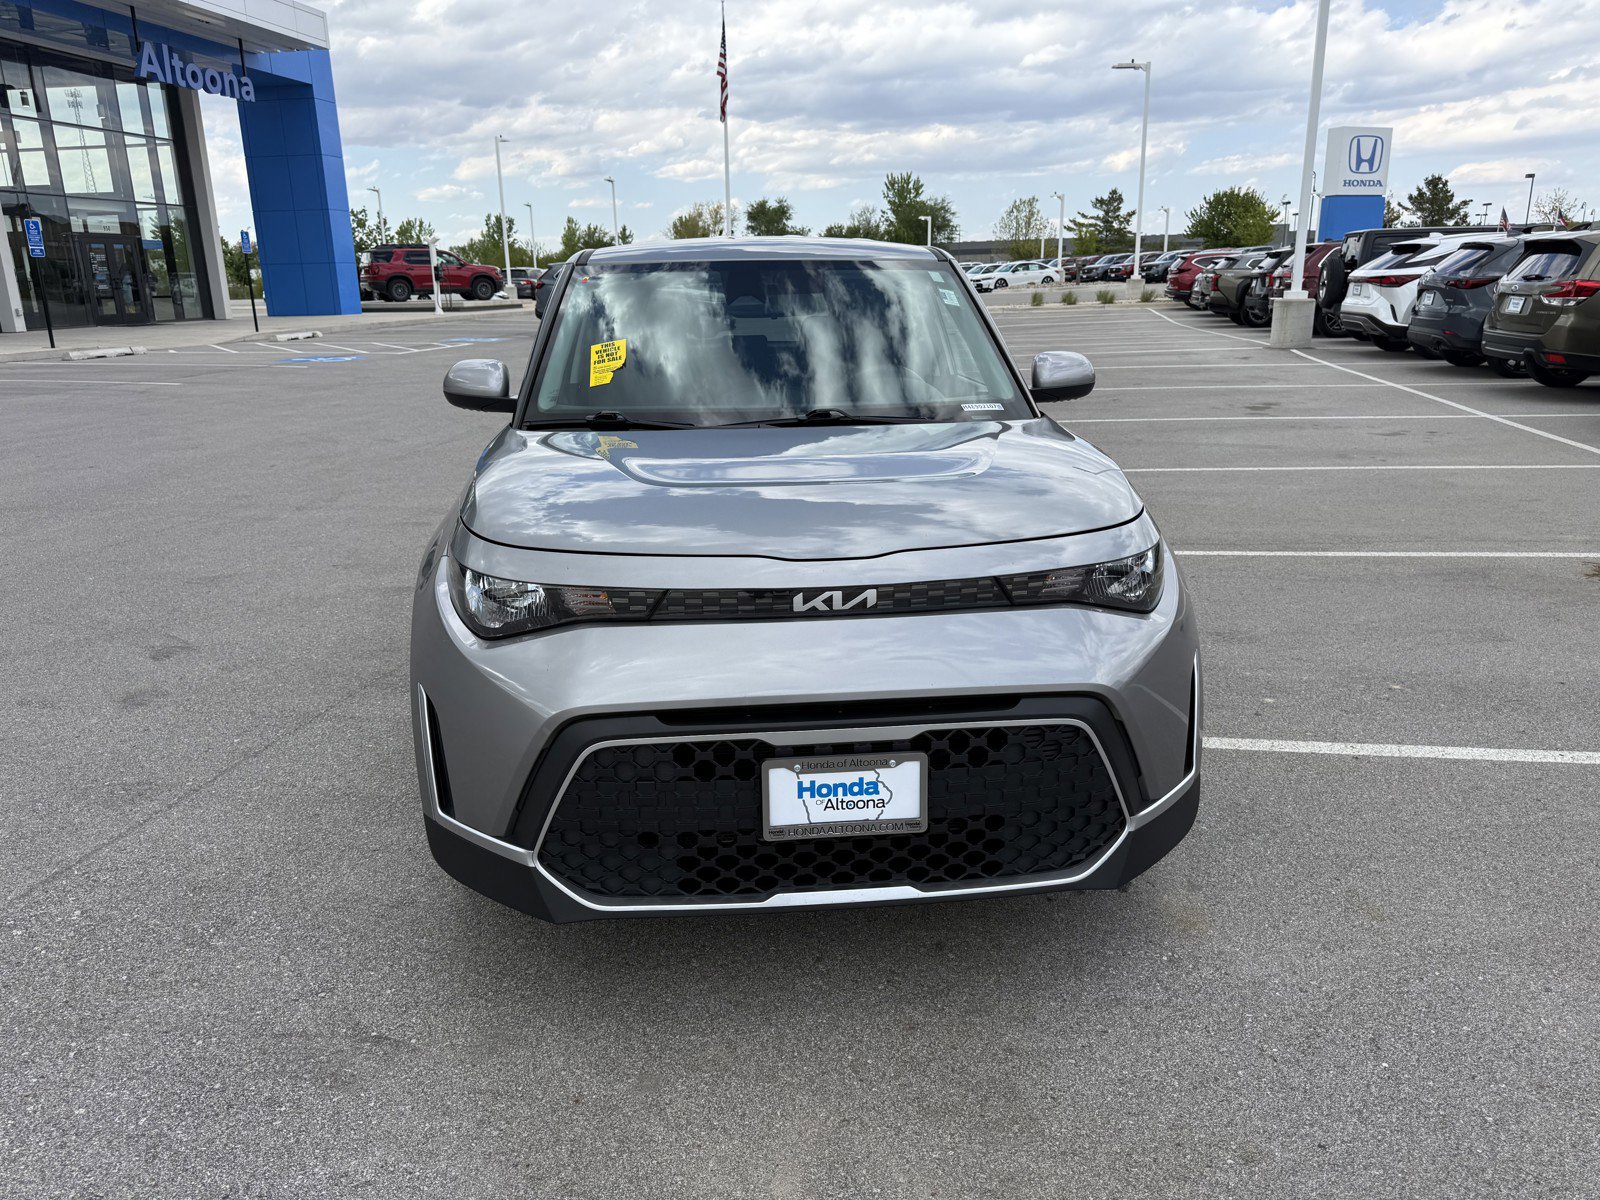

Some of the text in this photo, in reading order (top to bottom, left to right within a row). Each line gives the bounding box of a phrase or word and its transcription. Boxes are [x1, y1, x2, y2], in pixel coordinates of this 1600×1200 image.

[140, 41, 256, 102] Altoona
[1343, 179, 1383, 187] HONDA
[595, 346, 621, 354] VEHICLE
[793, 588, 877, 612] KIA
[801, 757, 888, 770] Honda of Altoona
[797, 777, 880, 799] Honda
[823, 798, 886, 811] Altoona
[788, 822, 904, 837] HONDAALTOONA.COM
